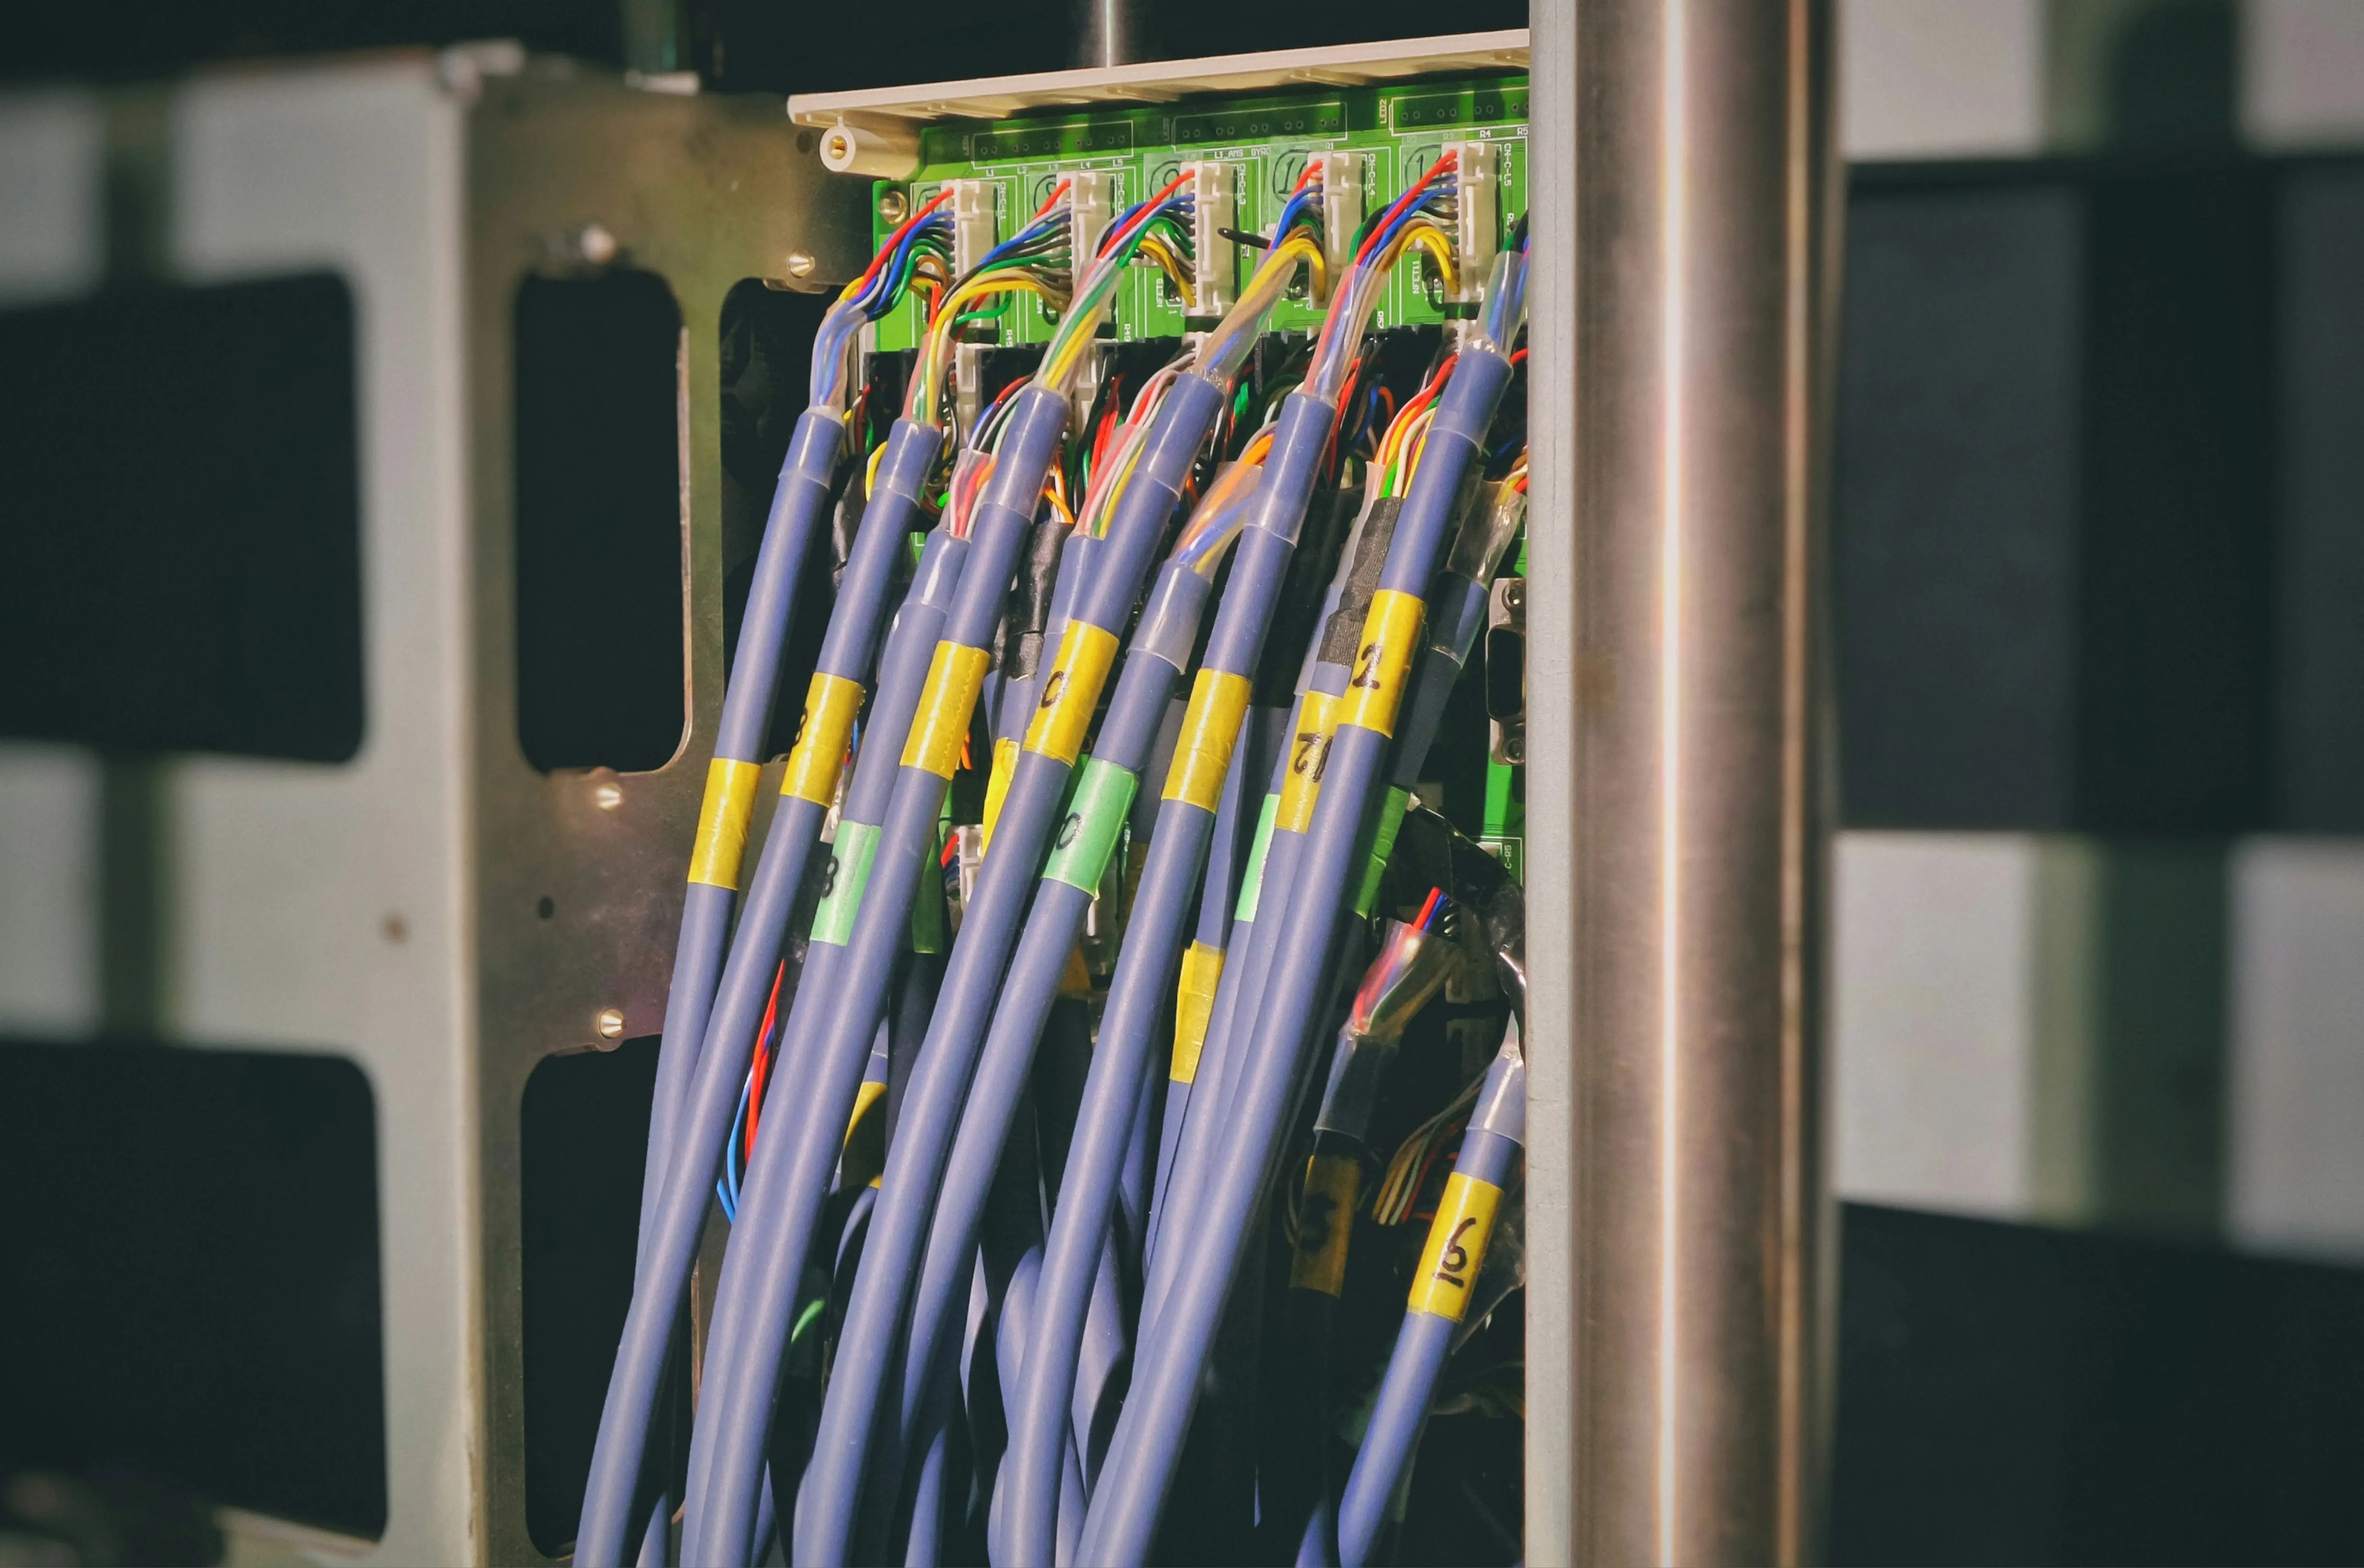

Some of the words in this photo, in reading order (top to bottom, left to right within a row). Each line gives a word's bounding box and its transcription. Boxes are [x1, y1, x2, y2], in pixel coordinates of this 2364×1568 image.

[1480, 129, 1491, 138] R4
[1517, 127, 1529, 136] R5
[1113, 159, 1123, 167] L5
[1017, 166, 1027, 174] L2
